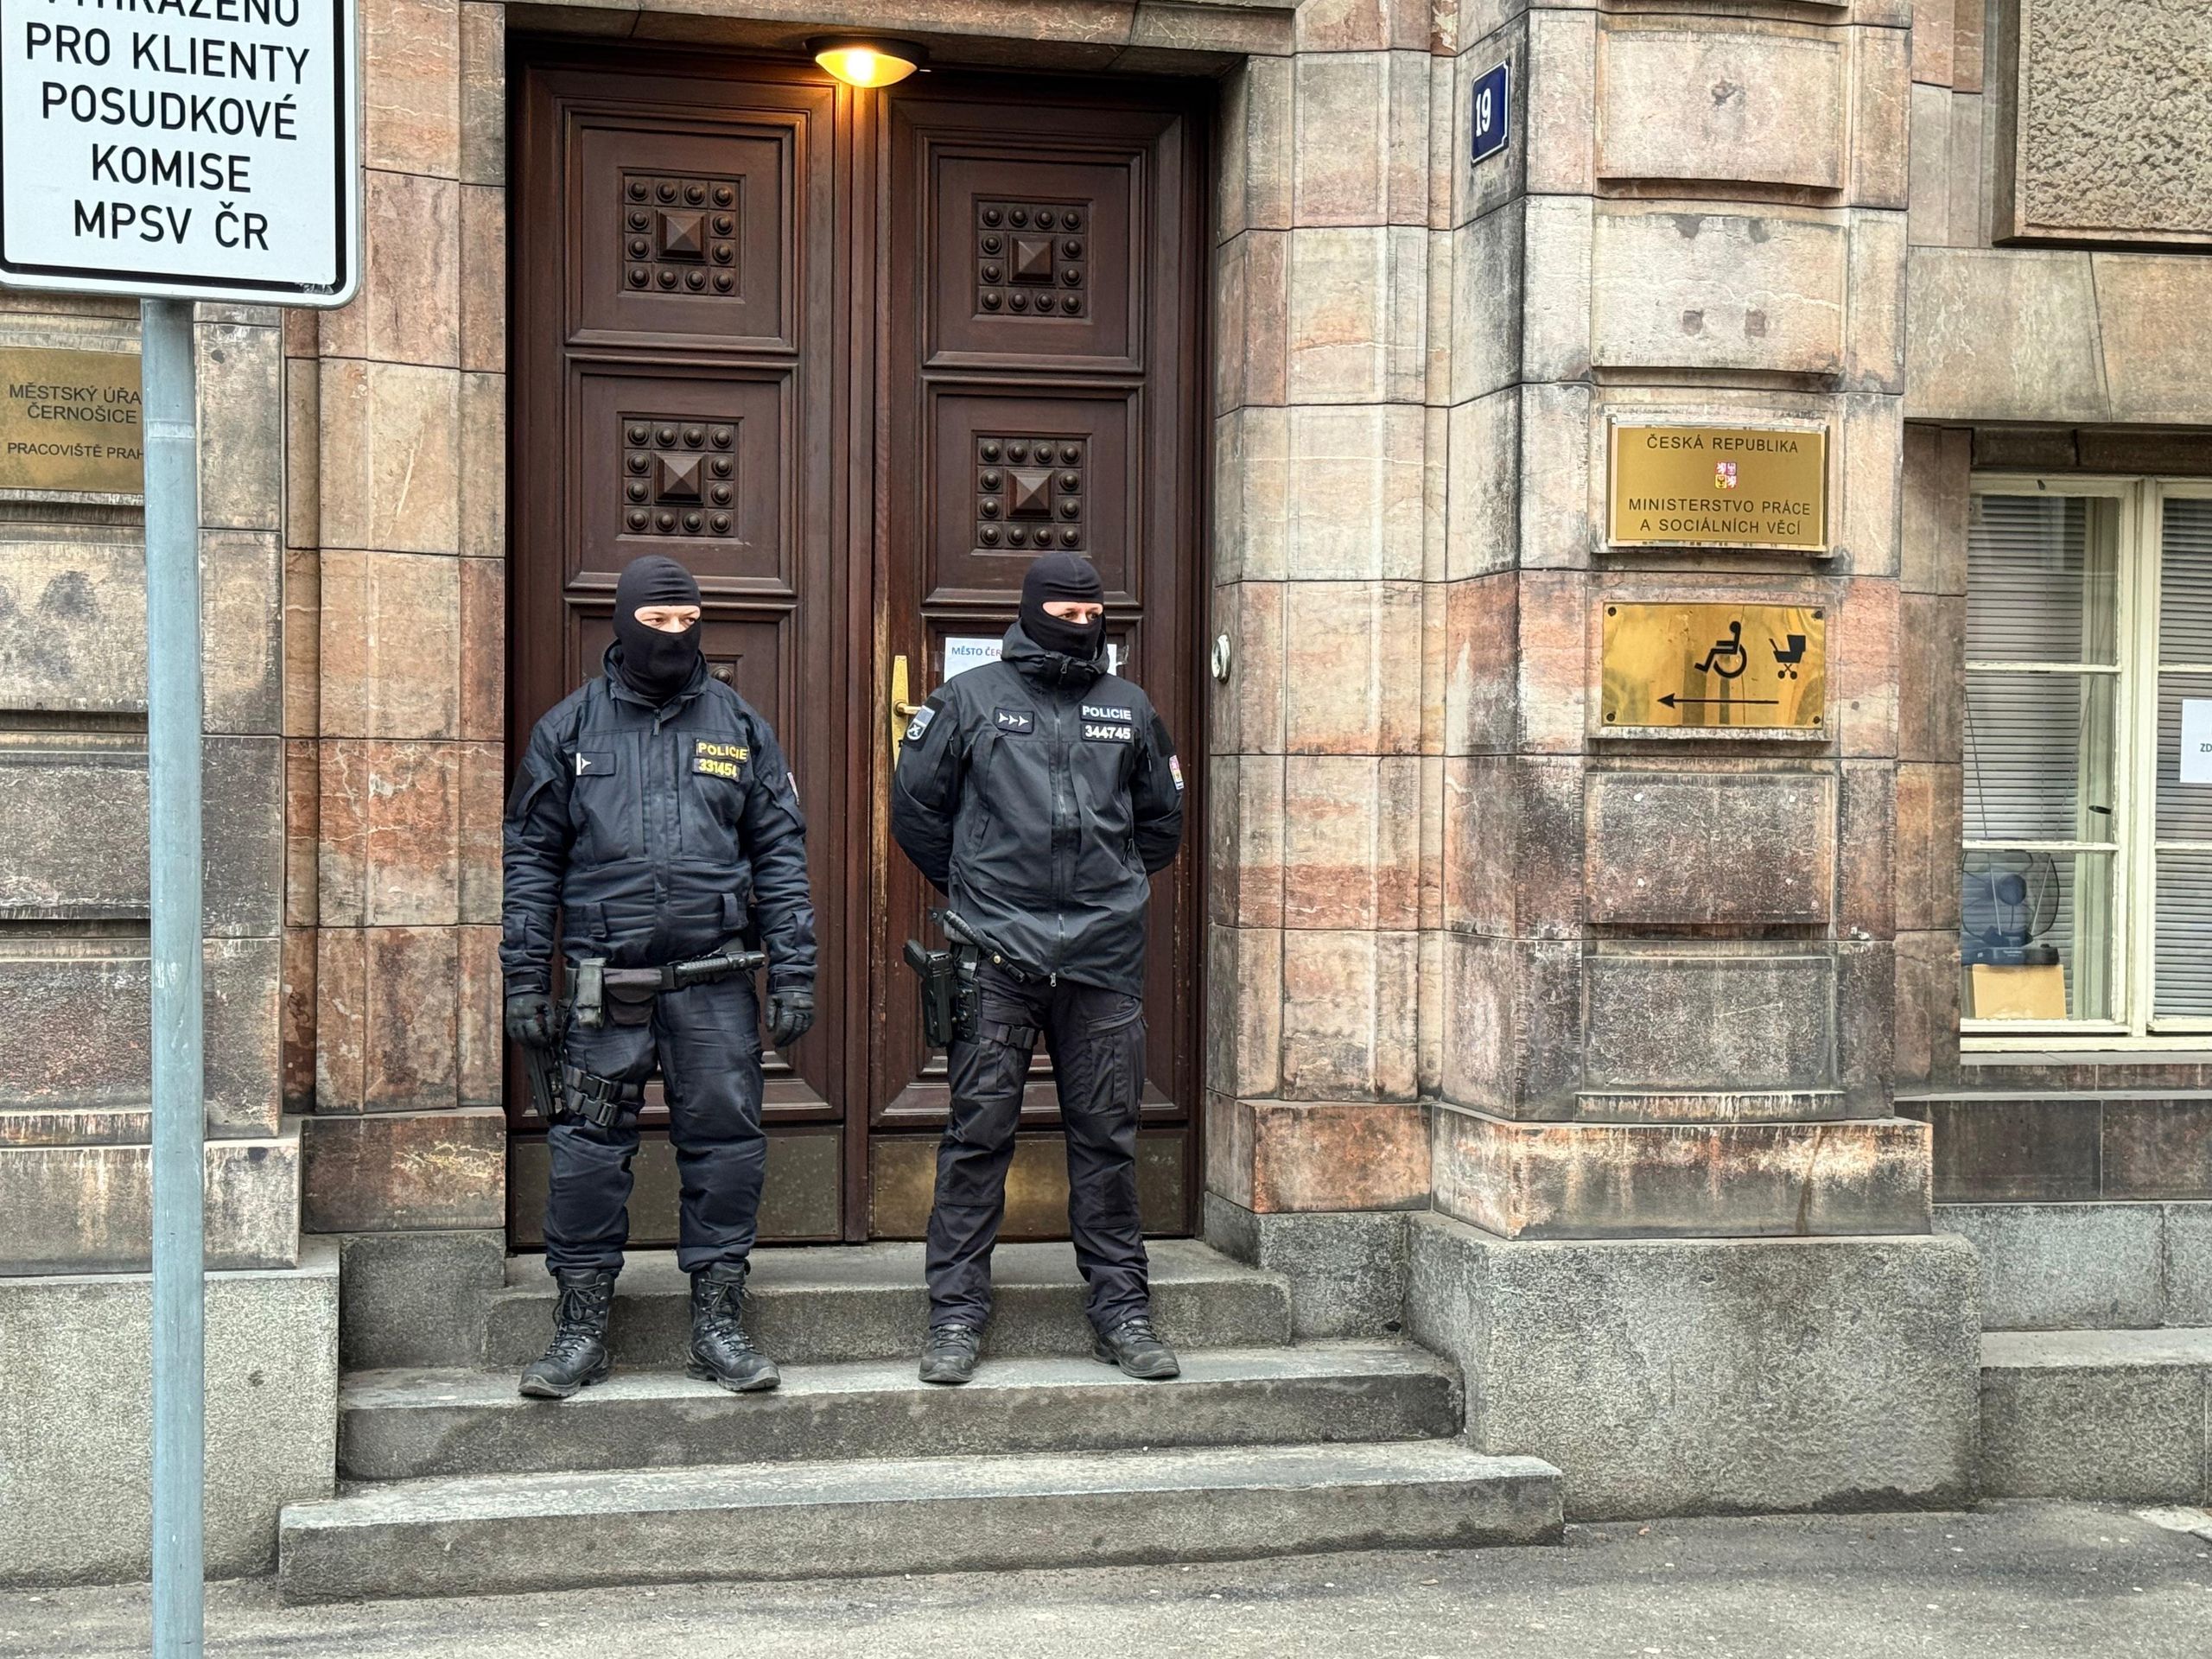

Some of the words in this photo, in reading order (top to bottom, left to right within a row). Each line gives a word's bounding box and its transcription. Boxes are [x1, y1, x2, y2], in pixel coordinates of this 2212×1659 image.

[27, 22, 111, 67] PRO
[132, 31, 310, 85] KLIENTY
[42, 81, 297, 141] POSUDKOVÉ
[1476, 88, 1491, 137] 19
[92, 143, 251, 194] KOMISE
[74, 200, 193, 245] MPSV
[215, 200, 270, 251] ČR
[9, 382, 99, 403] MĚSTSKÝ
[104, 385, 143, 405] ÚŘA
[28, 401, 137, 424] ČERNOŠICE
[8, 442, 103, 458] PRACOVIŠTĚ
[106, 447, 144, 460] PRAH
[1647, 434, 1704, 449] ČESKÁ
[1713, 437, 1798, 454] REPUBLIKA
[1629, 498, 1755, 513] MINISTERSTVO
[1762, 499, 1811, 516] PRÁCE
[1640, 518, 1651, 532] A
[1659, 517, 1759, 534] SOCIÁLNÍCH
[1767, 519, 1801, 536] VĚCÍ
[985, 646, 1002, 657] ČER
[1082, 705, 1132, 720] POLICIE
[1084, 725, 1131, 740] 344745
[698, 742, 747, 760] POLICIE
